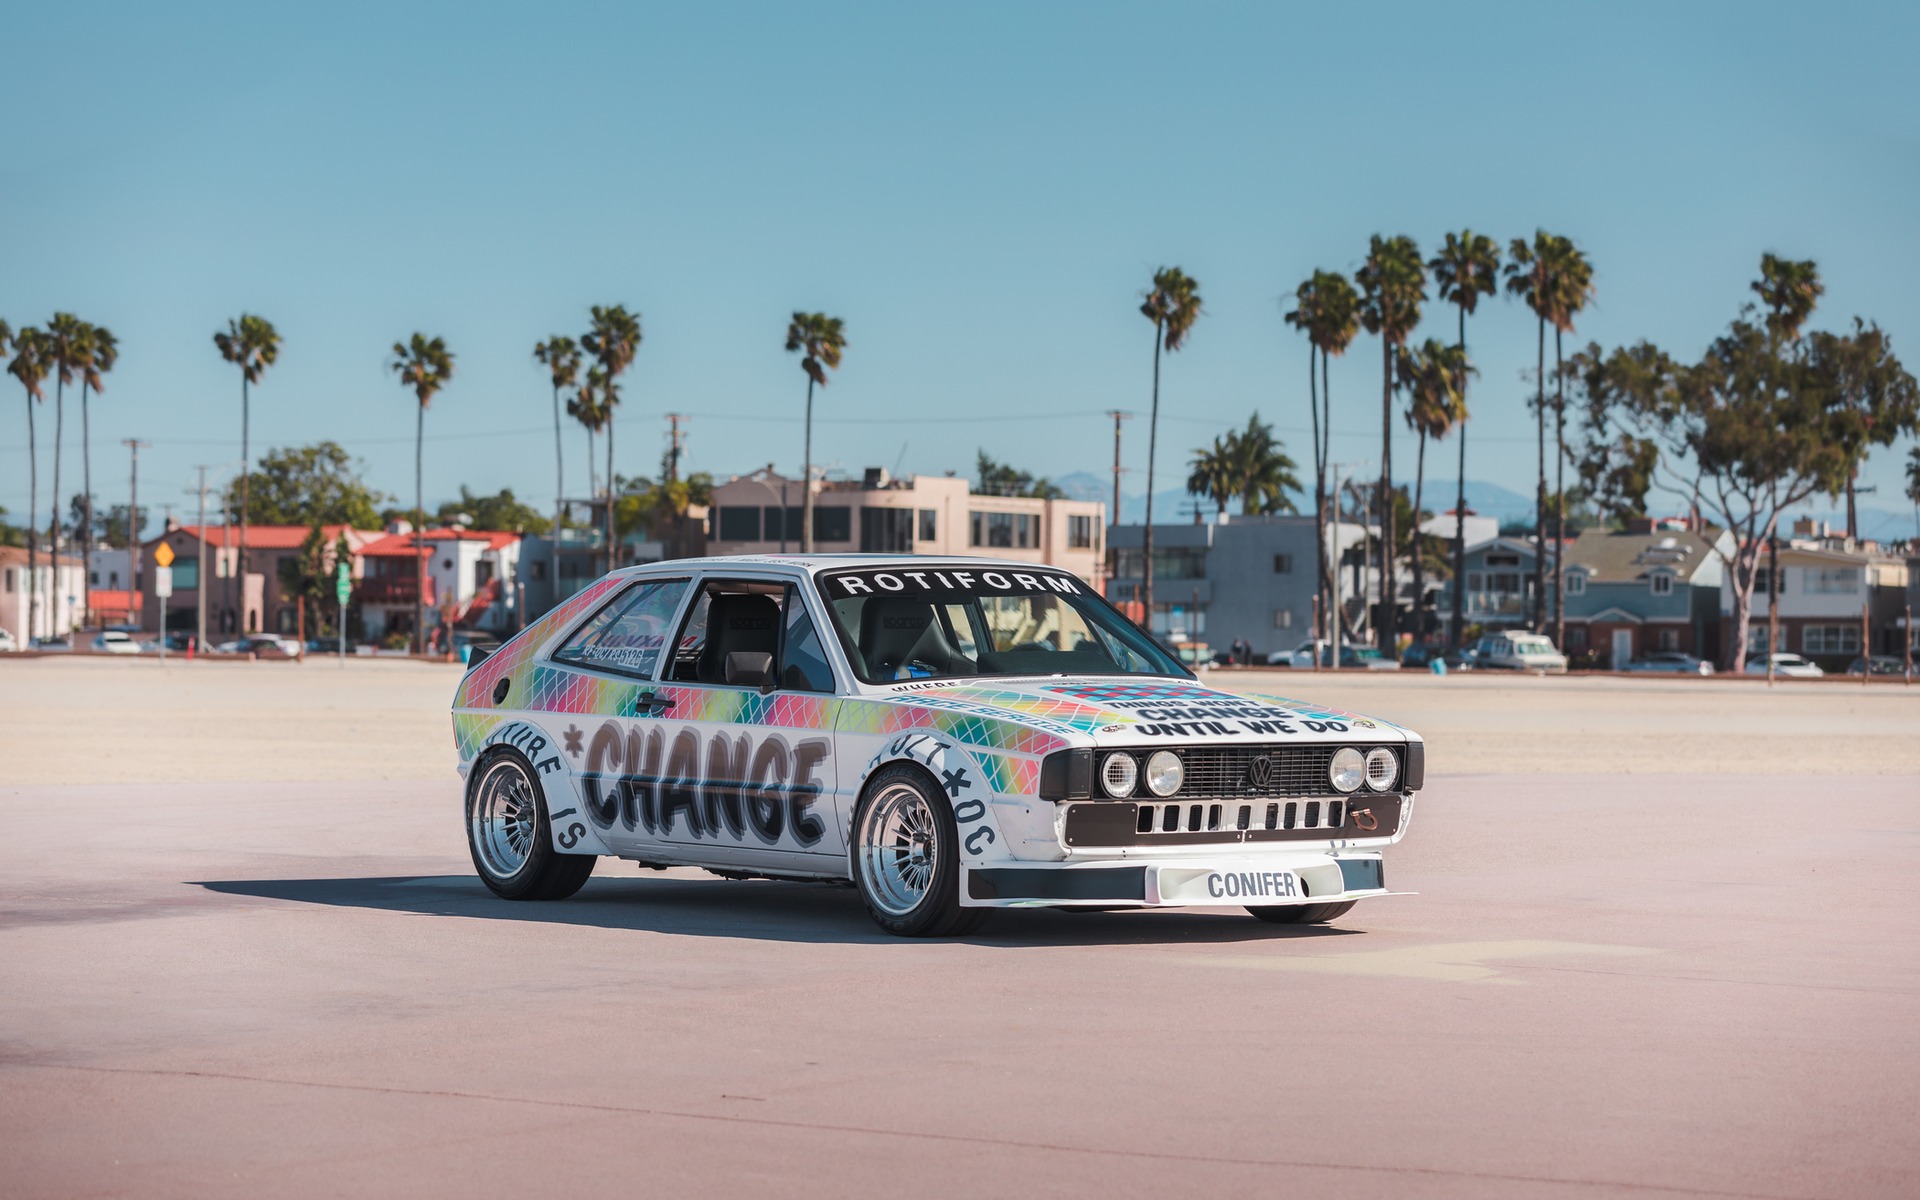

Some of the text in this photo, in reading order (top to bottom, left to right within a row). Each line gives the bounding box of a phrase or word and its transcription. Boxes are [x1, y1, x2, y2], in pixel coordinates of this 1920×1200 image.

[837, 571, 1082, 595] ROTIFORM
[883, 695, 975, 710] RACE
[969, 707, 1077, 734] SERVICE
[1103, 700, 1189, 709] THINGS
[1136, 707, 1295, 721] CHANGE
[1134, 720, 1240, 736] UNTIL
[1238, 719, 1298, 735] WE
[1298, 719, 1349, 733] DO
[478, 722, 561, 779] UTURE
[1207, 872, 1297, 898] CONIFER
